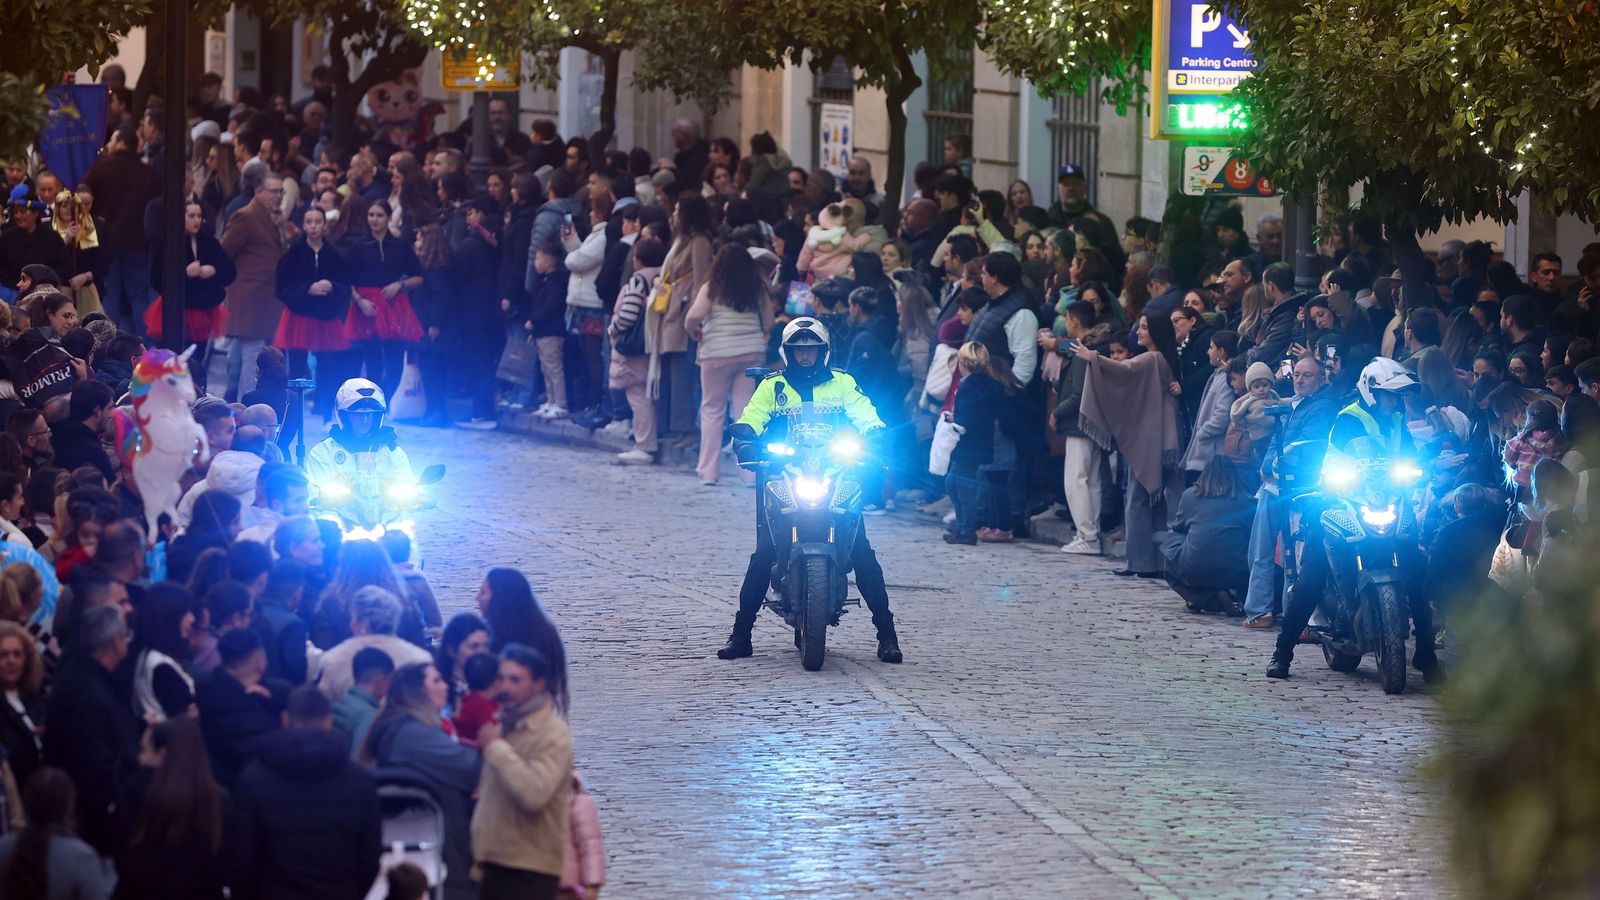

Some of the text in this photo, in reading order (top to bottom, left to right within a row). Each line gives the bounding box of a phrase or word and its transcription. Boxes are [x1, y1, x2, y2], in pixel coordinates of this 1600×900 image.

[1191, 4, 1221, 48] P
[1181, 57, 1258, 70] Parking Centro
[22, 366, 71, 398] PRIMOR
